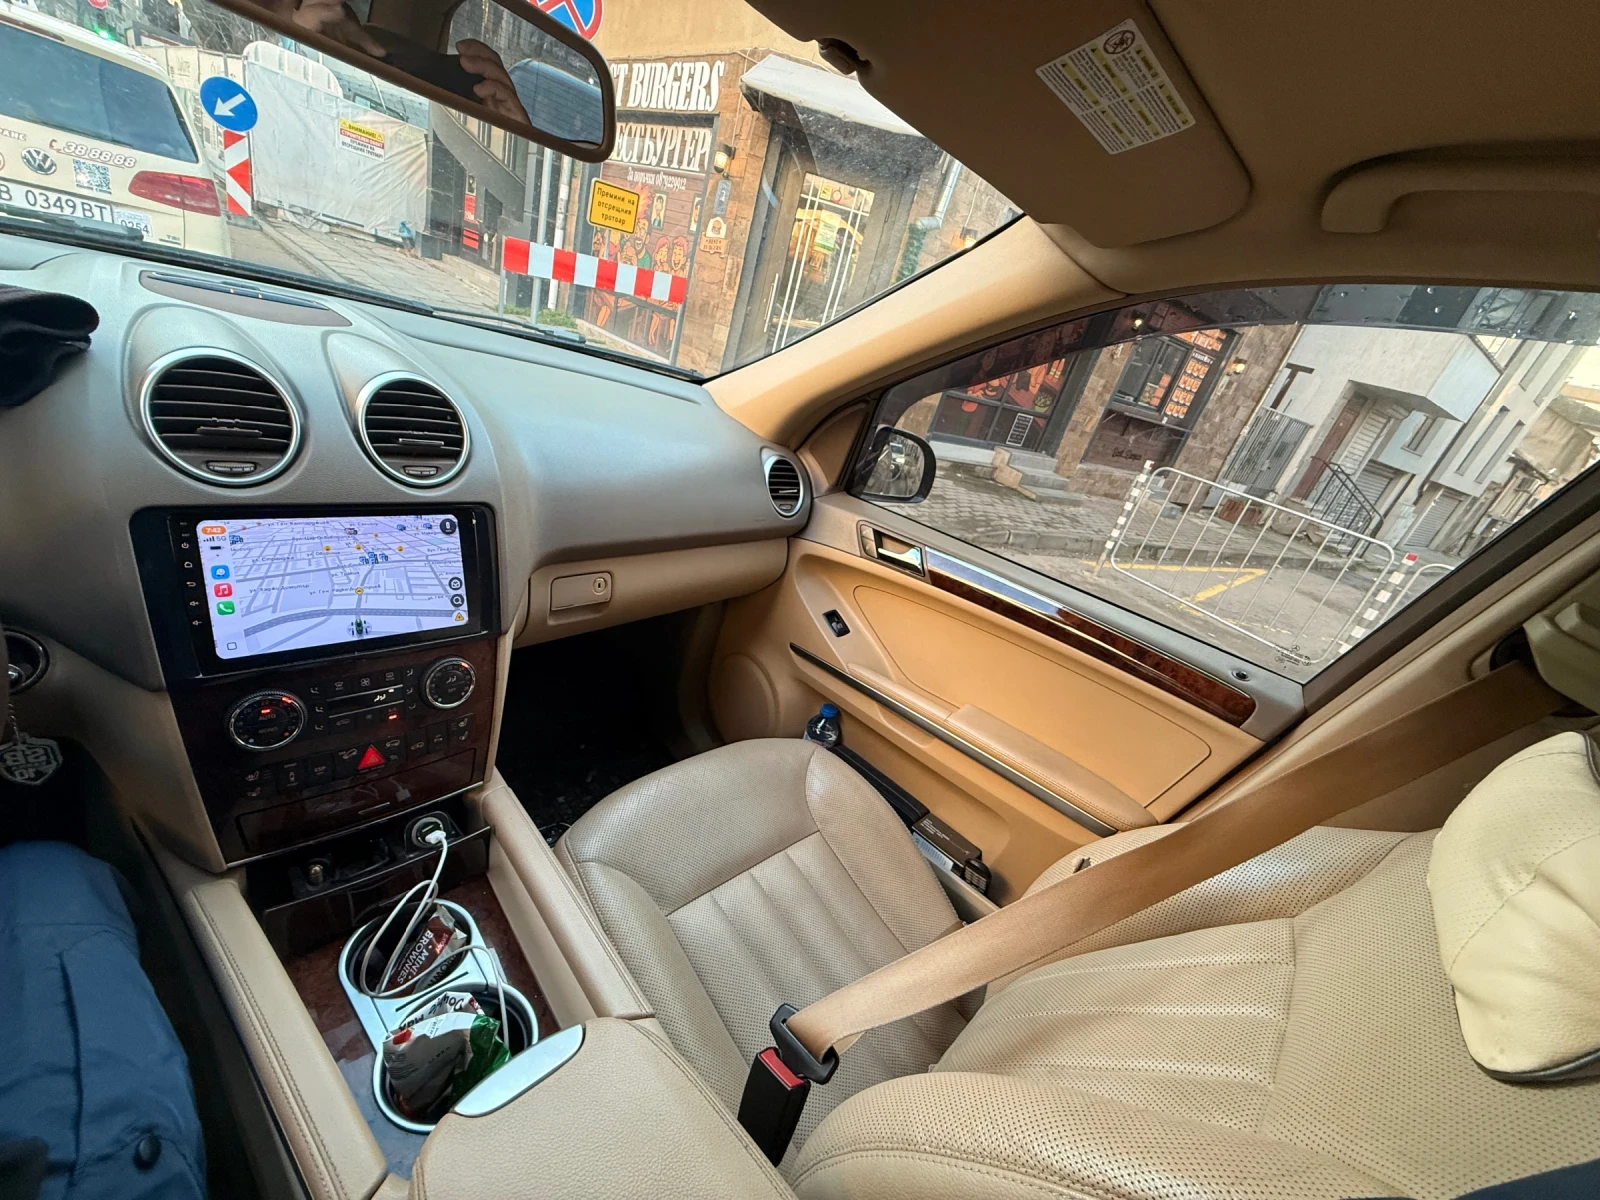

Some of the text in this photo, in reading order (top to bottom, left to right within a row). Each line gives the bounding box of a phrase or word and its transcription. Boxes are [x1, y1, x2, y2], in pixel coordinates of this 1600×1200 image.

[627, 60, 725, 112] BURGERS
[348, 123, 377, 139] ВНИМАНИЕ!
[25, 189, 76, 215] 0349
[597, 187, 625, 202] Премини
[597, 200, 632, 216] отсрещния
[601, 213, 626, 226] тротоар
[397, 929, 435, 985] BROWNIES
[409, 948, 430, 976] MINI
